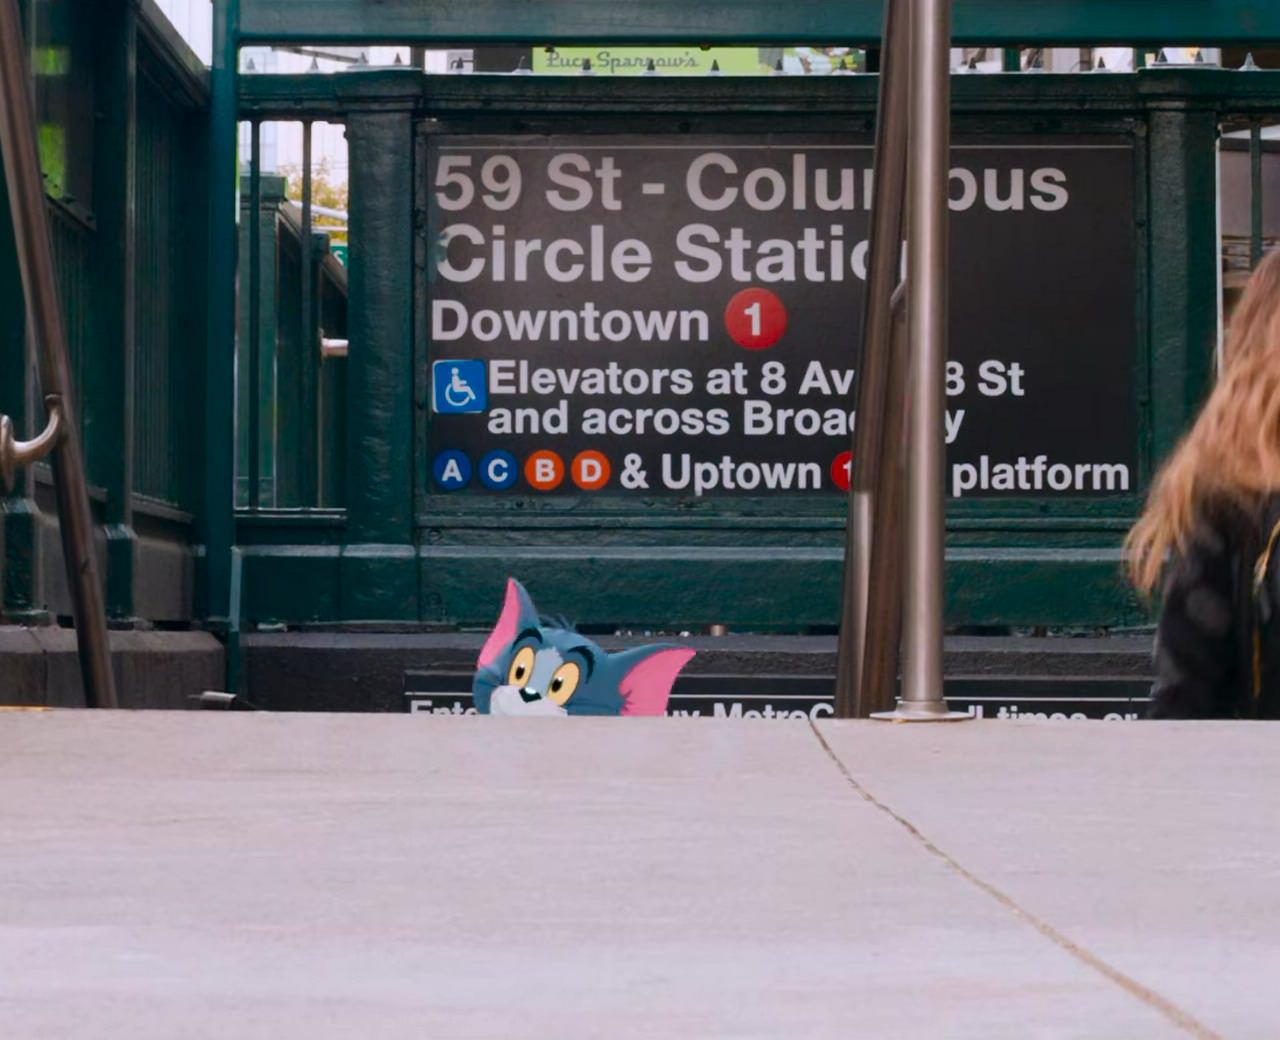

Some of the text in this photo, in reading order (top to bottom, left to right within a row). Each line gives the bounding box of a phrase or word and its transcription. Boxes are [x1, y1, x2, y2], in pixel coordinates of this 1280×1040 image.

[435, 155, 522, 212] 59
[545, 153, 623, 212] St
[685, 152, 1068, 212] Colubus
[437, 224, 907, 283] Circle Stati
[432, 299, 761, 342] Downtown 1
[489, 359, 694, 395] Elevators
[706, 362, 748, 395] at
[760, 361, 787, 395] 8
[977, 360, 1025, 397] St
[487, 400, 965, 444] and across Broay
[442, 459, 462, 482] A
[487, 459, 508, 482] C
[535, 459, 555, 482] B
[581, 459, 602, 482] D
[620, 453, 649, 489] &
[662, 453, 821, 497] Uptown
[952, 455, 1129, 498] platform
